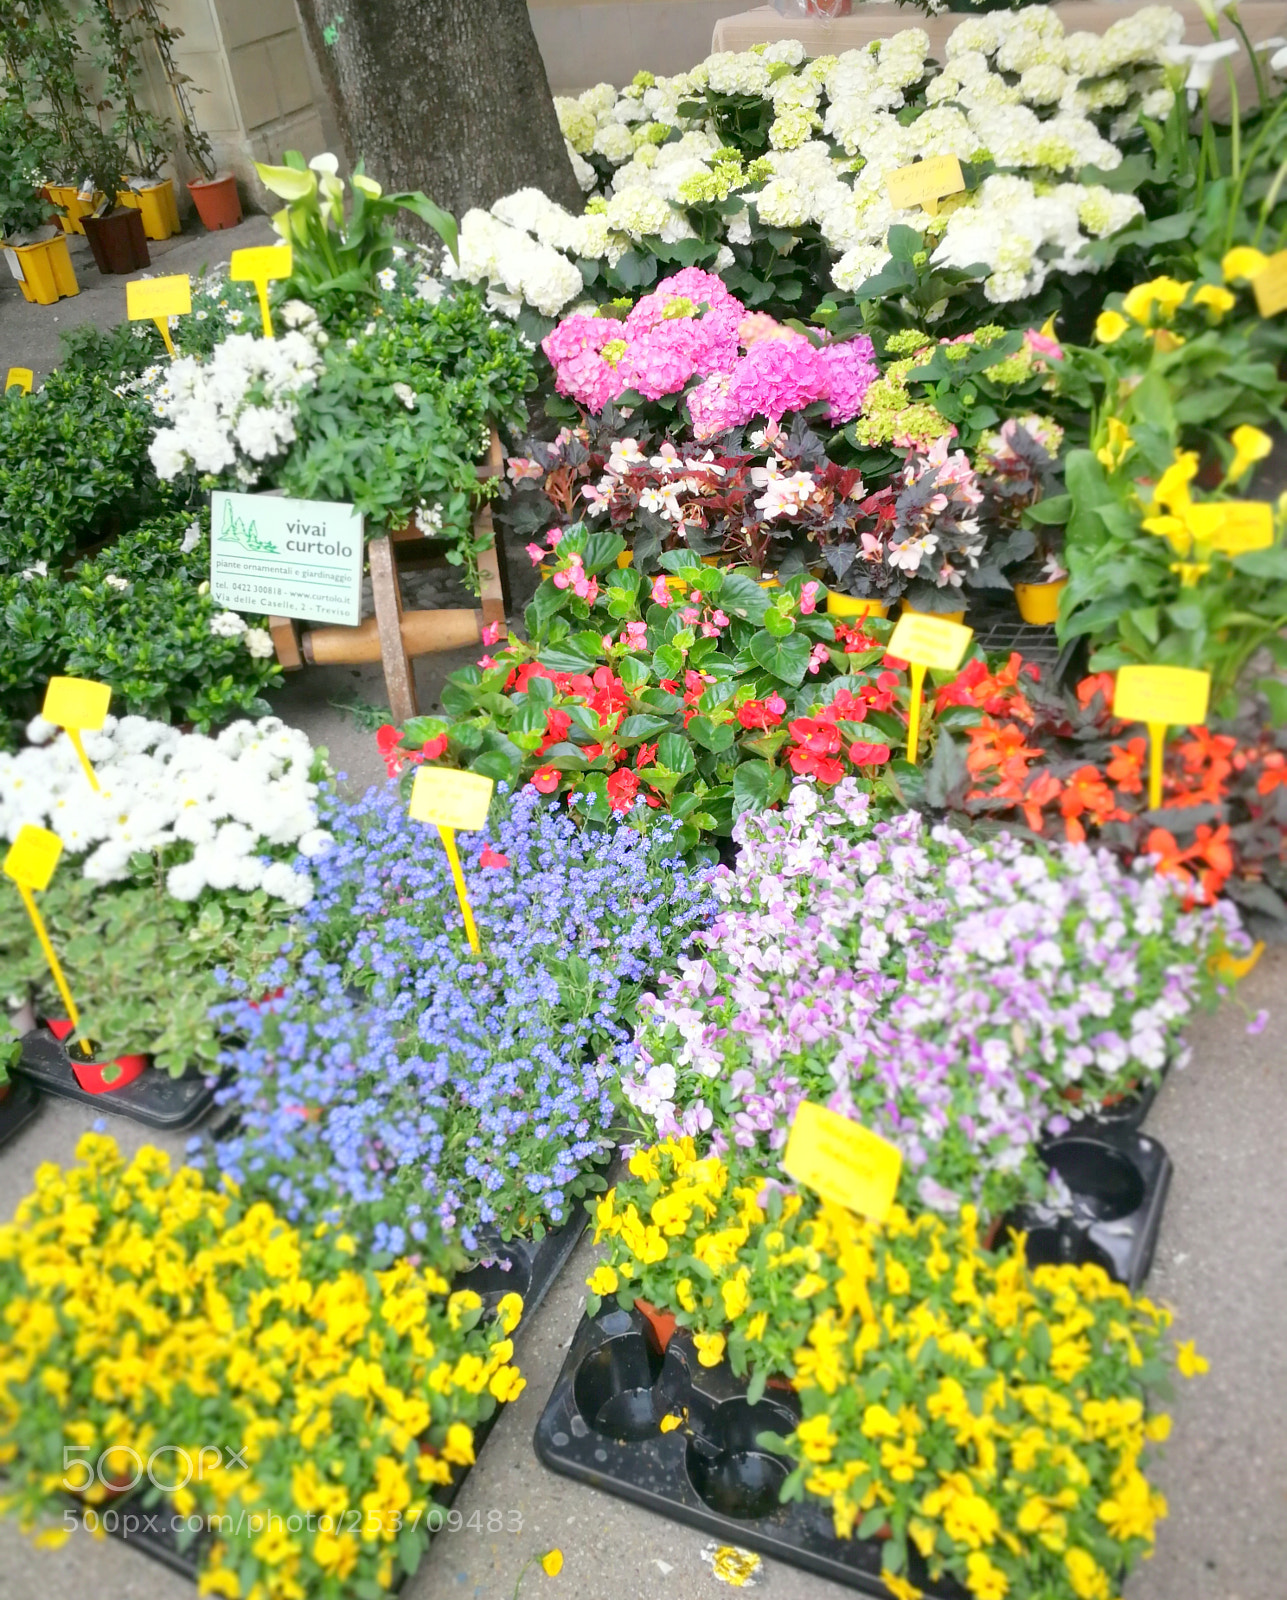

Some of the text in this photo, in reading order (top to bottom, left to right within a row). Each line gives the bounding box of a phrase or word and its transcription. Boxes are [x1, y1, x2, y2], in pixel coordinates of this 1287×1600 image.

[286, 520, 326, 537] vivai
[286, 540, 353, 558] curtolo
[216, 560, 241, 569] piante
[243, 564, 293, 575] ornamentali
[302, 570, 352, 584] giardinaggio
[215, 582, 229, 590] tel.
[232, 582, 251, 592] 0422
[253, 585, 282, 596] 300818
[290, 591, 351, 605] www.curtolo.it
[215, 592, 230, 602] Via
[233, 595, 257, 605] delle
[260, 598, 298, 611] Caselle,
[301, 603, 306, 611] 2
[316, 605, 351, 617] Treviso
